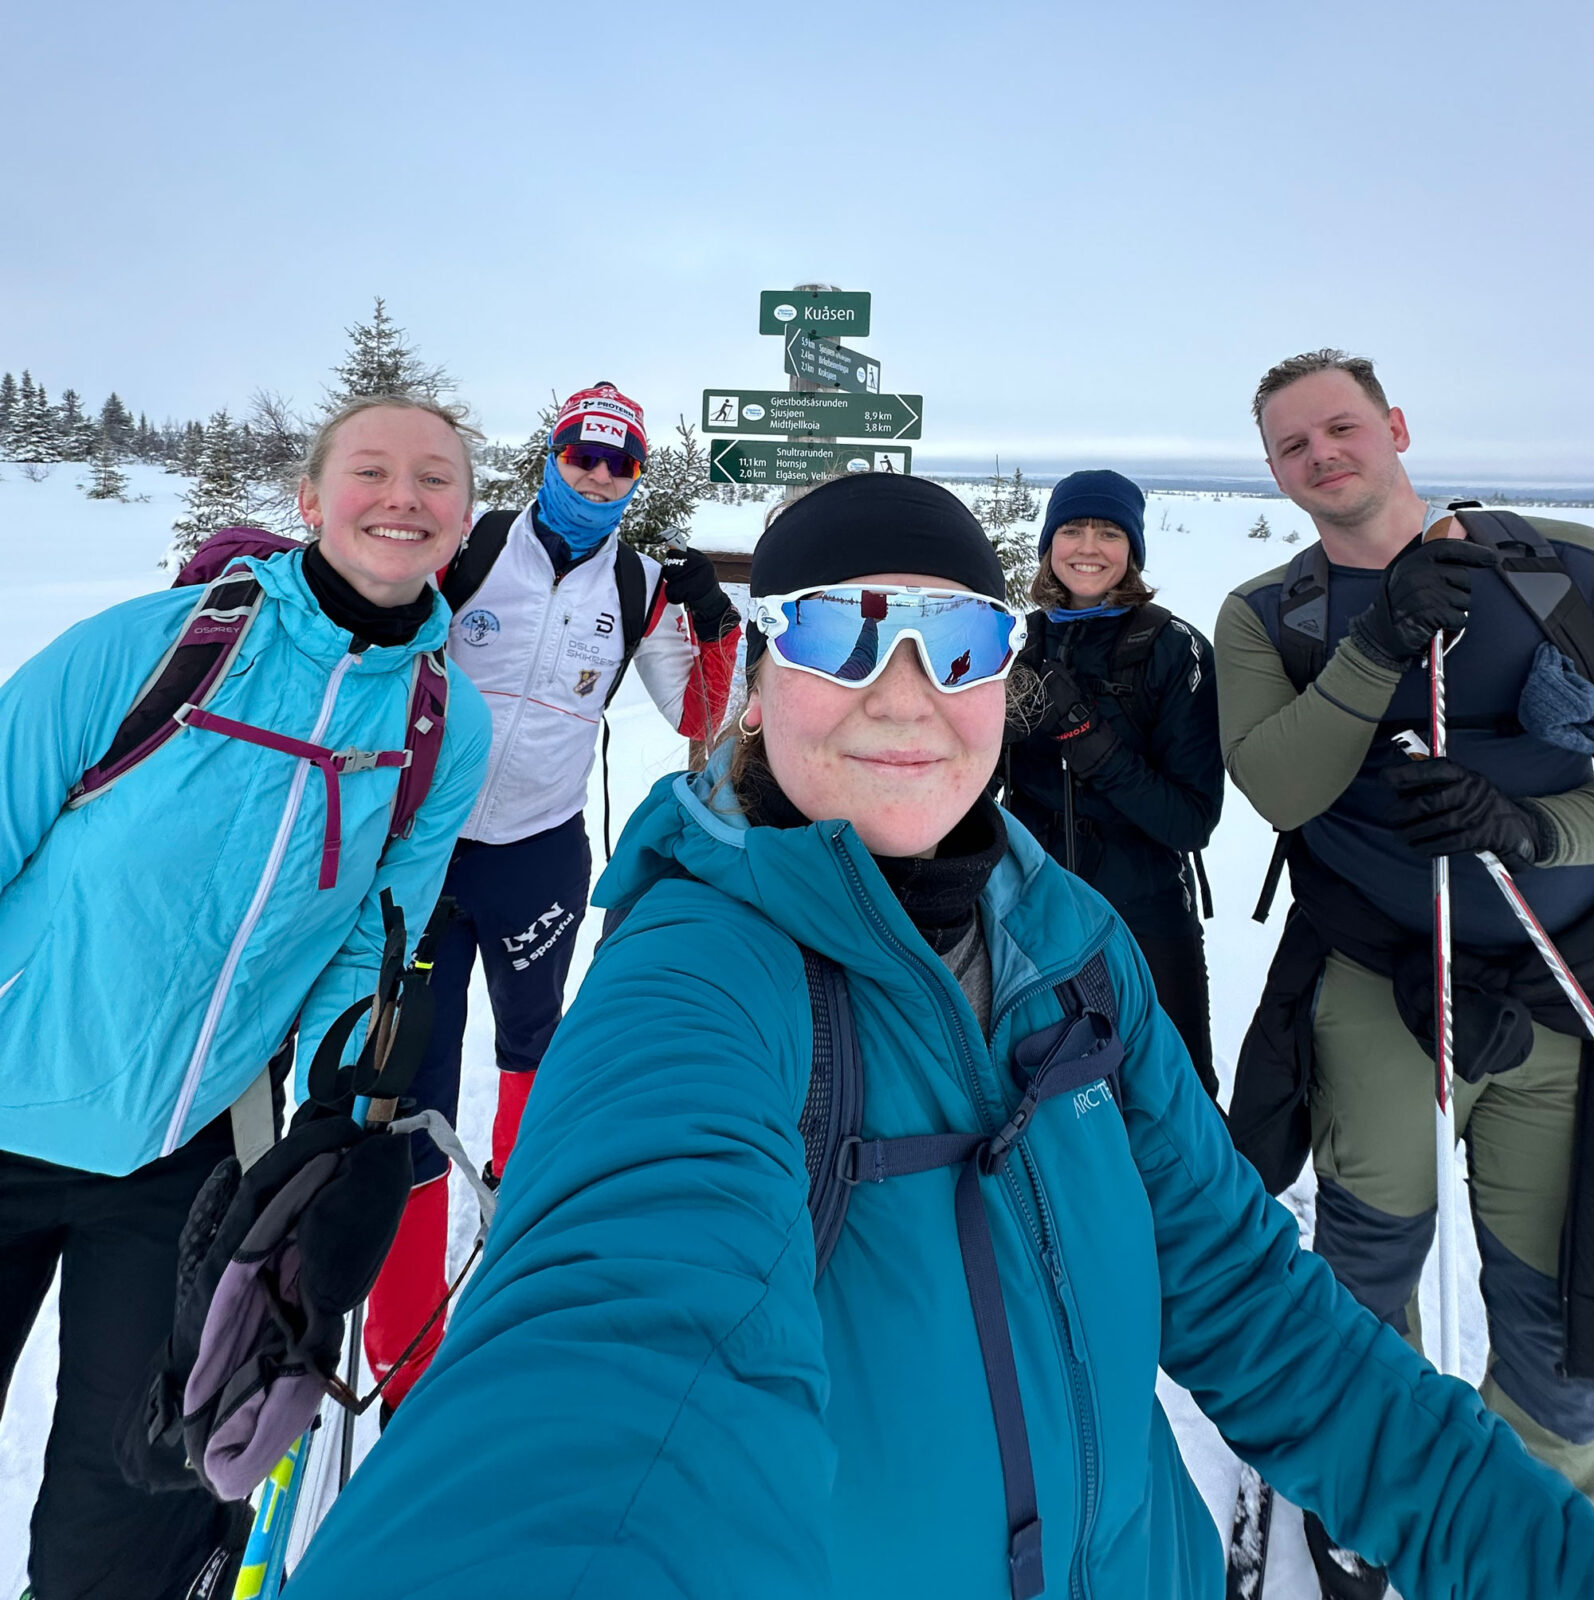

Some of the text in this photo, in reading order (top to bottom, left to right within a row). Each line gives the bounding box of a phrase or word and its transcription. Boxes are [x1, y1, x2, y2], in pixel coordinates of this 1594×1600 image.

[804, 305, 855, 321] Kuåsen
[770, 397, 848, 408] Gjestbodsåsrunden
[770, 408, 805, 419] Sjusjøen
[864, 411, 878, 421] 8,9
[879, 411, 892, 421] km
[585, 423, 624, 438] LYN
[769, 420, 892, 433] Midtfjellkoia 3,8 km
[776, 448, 834, 458] Snultrarunden
[739, 458, 807, 469] 11,1 km Hornsjø
[739, 469, 752, 478] 2,0
[753, 469, 767, 478] km
[775, 470, 809, 481] Elgåsen,
[194, 626, 239, 634] OSPREY
[569, 640, 600, 655] OSLO
[502, 902, 564, 953] LYN
[529, 912, 575, 961] sportful
